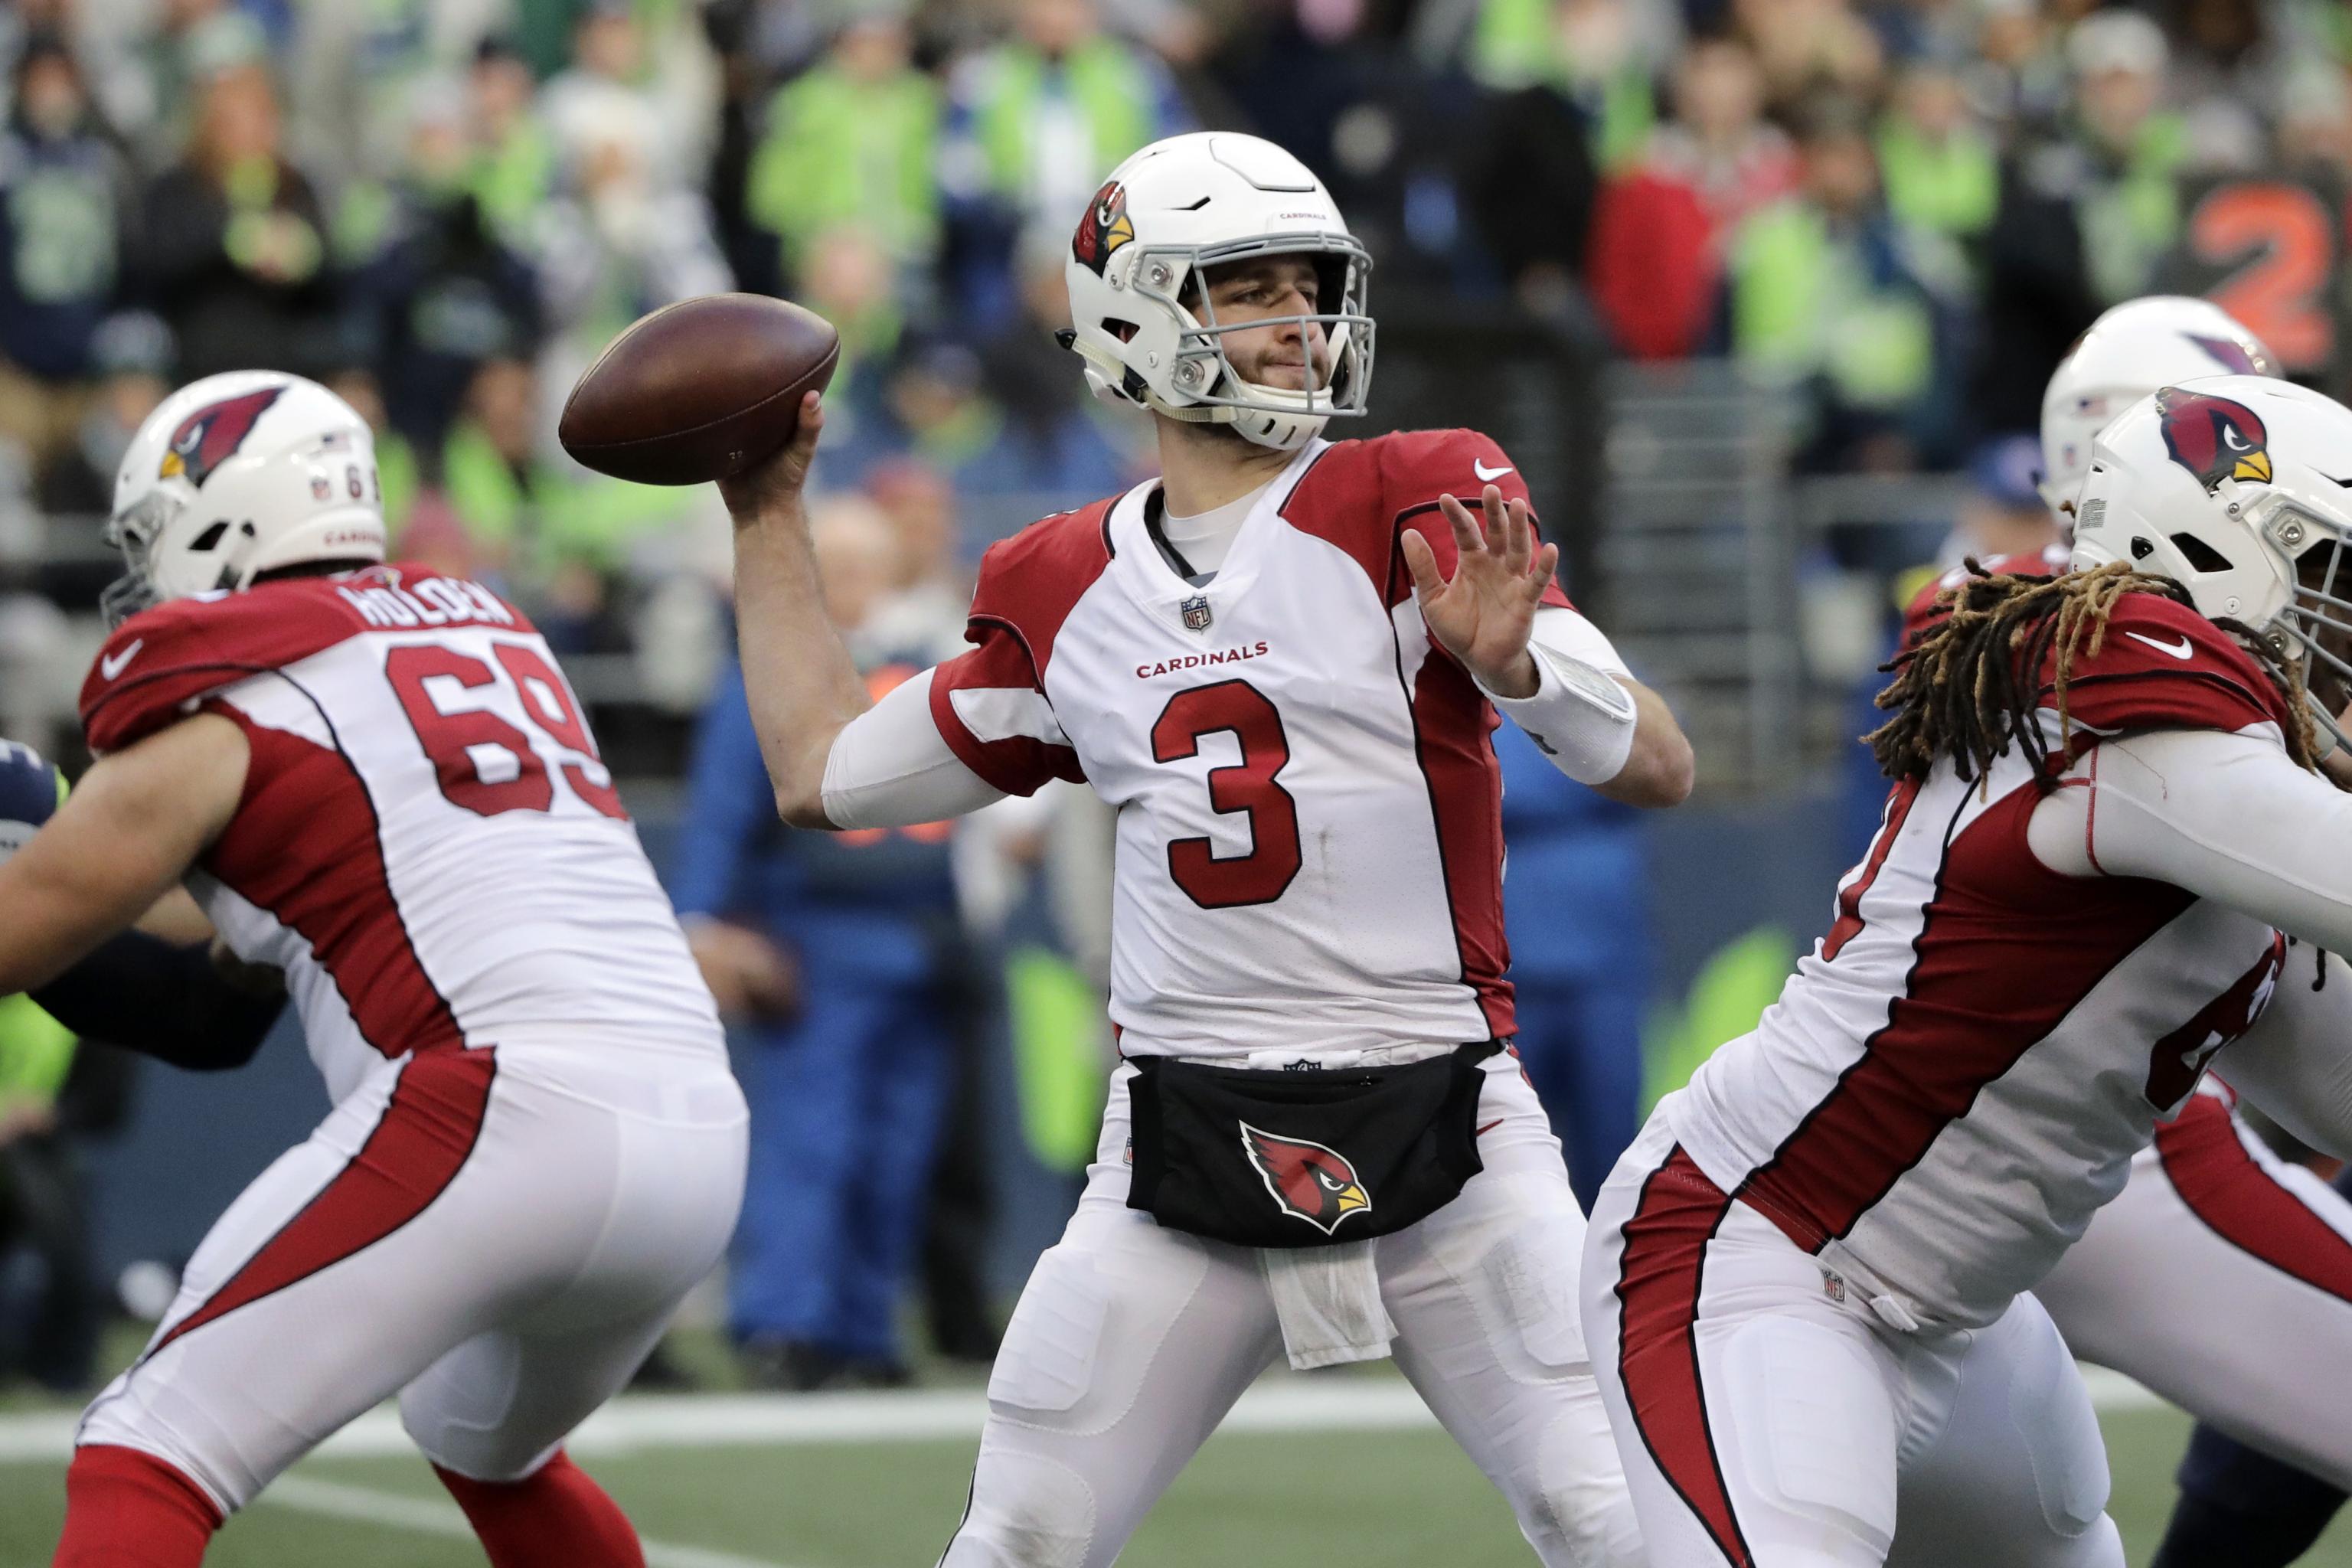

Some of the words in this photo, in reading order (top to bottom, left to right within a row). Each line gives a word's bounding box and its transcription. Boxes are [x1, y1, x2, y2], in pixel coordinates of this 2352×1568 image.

[2191, 181, 2332, 369] 2
[384, 642, 630, 818] 69
[1136, 642, 1269, 679] CARDINALS
[1150, 678, 1302, 910] 3
